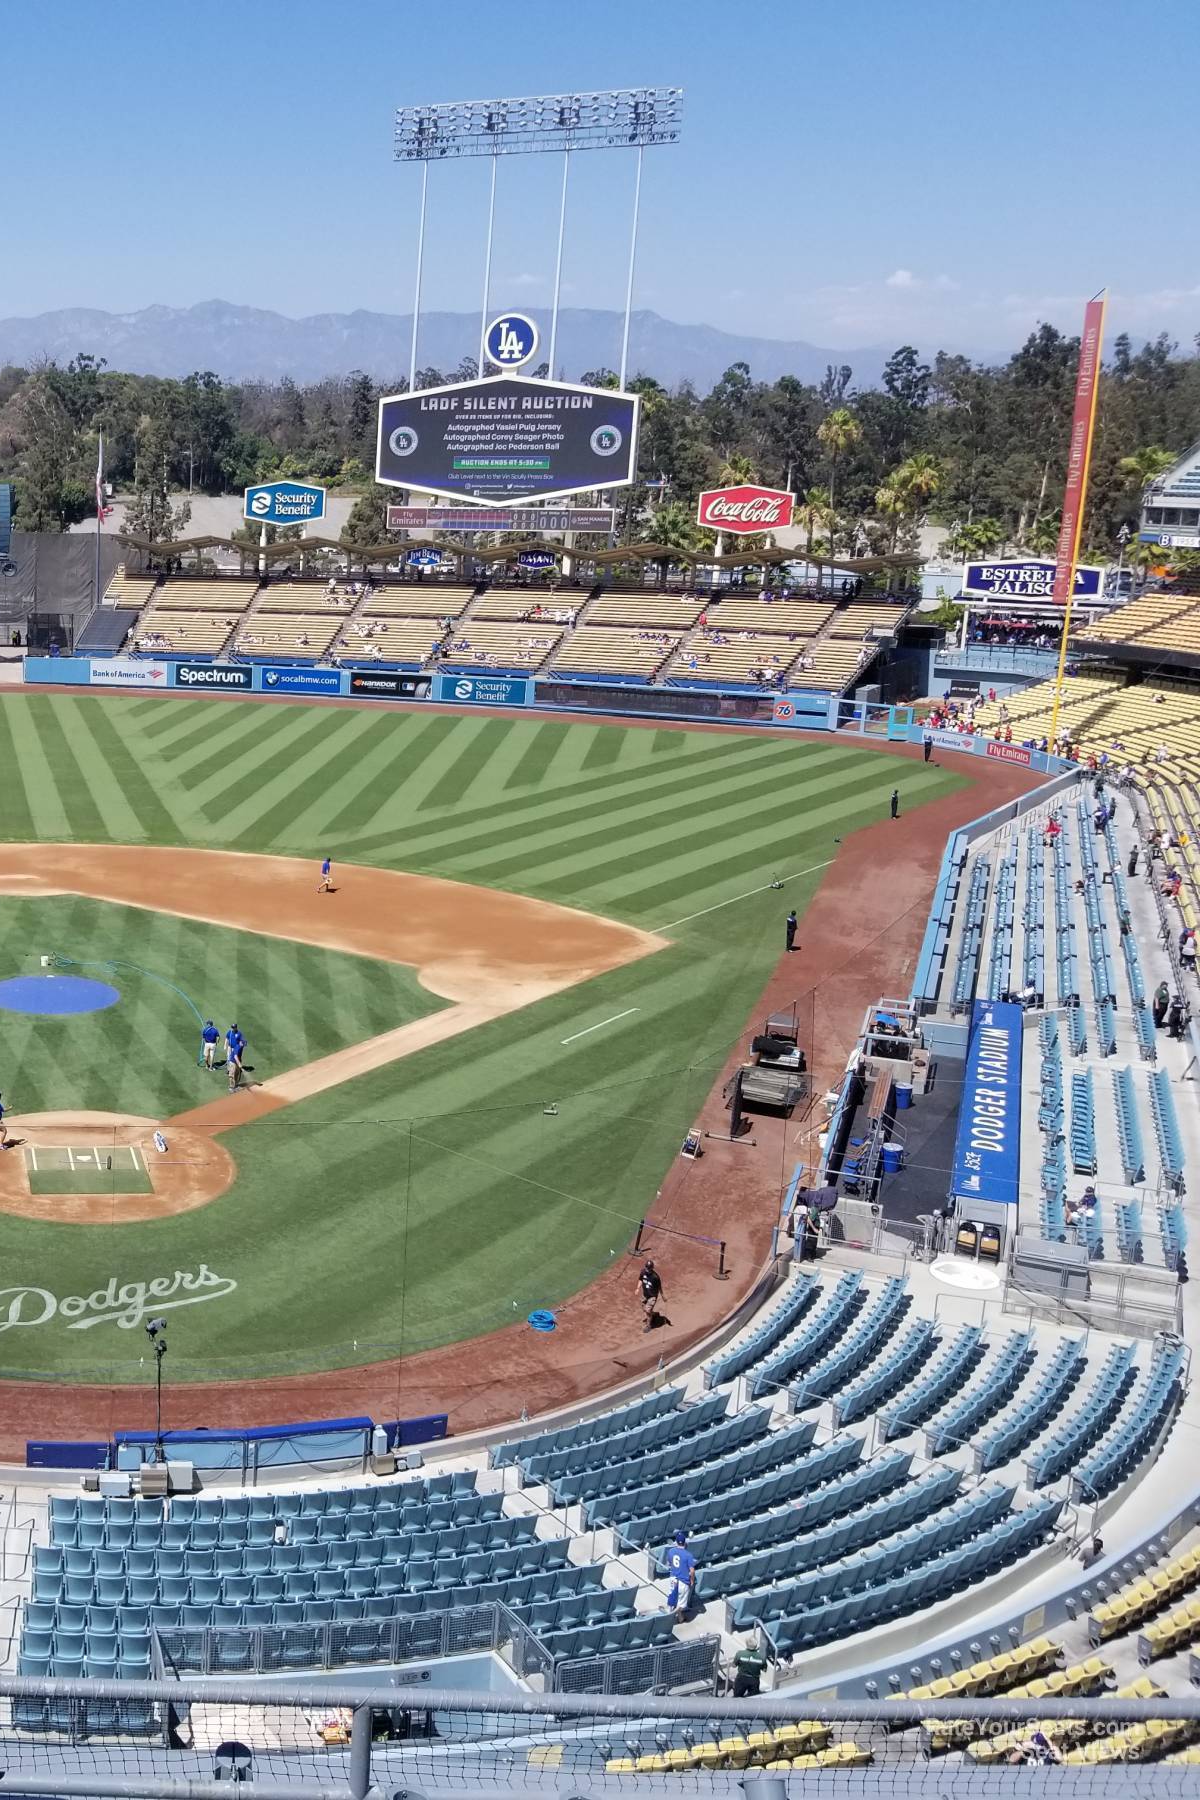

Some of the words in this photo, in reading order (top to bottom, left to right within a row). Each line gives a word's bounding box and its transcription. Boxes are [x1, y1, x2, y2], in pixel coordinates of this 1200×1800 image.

[497, 322, 524, 359] LA
[1080, 327, 1096, 375] Emirates
[1077, 377, 1091, 396] Fly
[420, 398, 459, 410] LADF
[463, 397, 518, 410] SILENT
[521, 396, 594, 410] AUCTION
[447, 424, 495, 432] Autographed
[518, 424, 536, 432] Puig
[536, 424, 562, 432] Jersey
[1069, 420, 1085, 468] Emirates
[1067, 469, 1080, 489] Fly
[275, 492, 318, 505] Security
[275, 504, 312, 515] Benefit
[705, 496, 786, 523] Coca-Cola
[540, 517, 546, 529] 0
[550, 517, 557, 529] 0
[560, 517, 567, 529] 0
[1058, 512, 1073, 558] Emirates
[408, 551, 421, 562] JIM
[422, 550, 441, 563] BEAM
[519, 554, 554, 565] DASANI
[1054, 558, 1069, 579] Fly
[980, 567, 1085, 585] ESTRELA
[92, 670, 110, 678] Bank
[110, 670, 118, 678] of
[117, 670, 146, 679] America
[179, 667, 244, 684] Spectrum
[280, 674, 338, 686] socalbmw.com
[475, 680, 512, 694] Security
[475, 691, 506, 701] Benefit
[776, 705, 791, 716] 76
[941, 737, 961, 747] America
[989, 743, 1001, 756] Fly
[1000, 746, 1029, 762] Emirates
[977, 1027, 1010, 1084] STADIUM
[970, 1087, 1007, 1153] DODGER
[672, 1555, 681, 1568] 6
